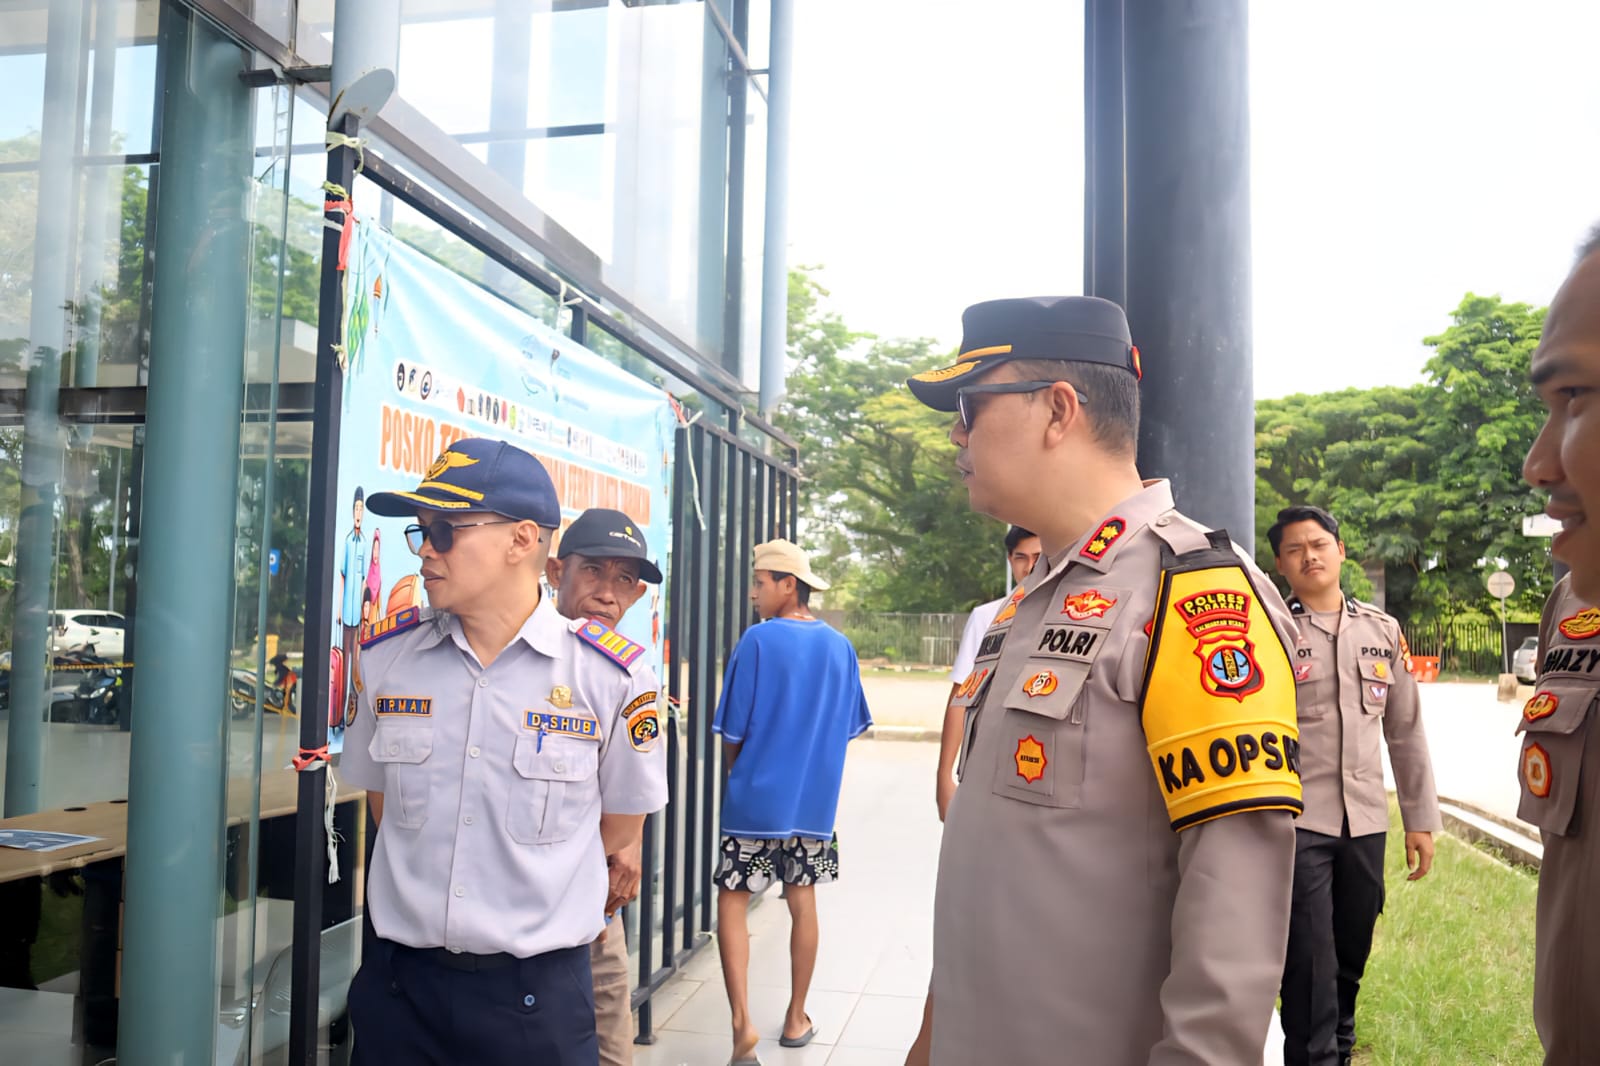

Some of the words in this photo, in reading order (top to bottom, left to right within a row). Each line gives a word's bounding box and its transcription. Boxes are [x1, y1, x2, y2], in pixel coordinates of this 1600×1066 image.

[381, 405, 435, 475] POSKO
[1184, 593, 1245, 613] POLRES
[1038, 629, 1098, 656] POLRI
[378, 699, 429, 714] FIRMAN
[531, 714, 592, 733] DSHUB
[1158, 747, 1205, 794] KA
